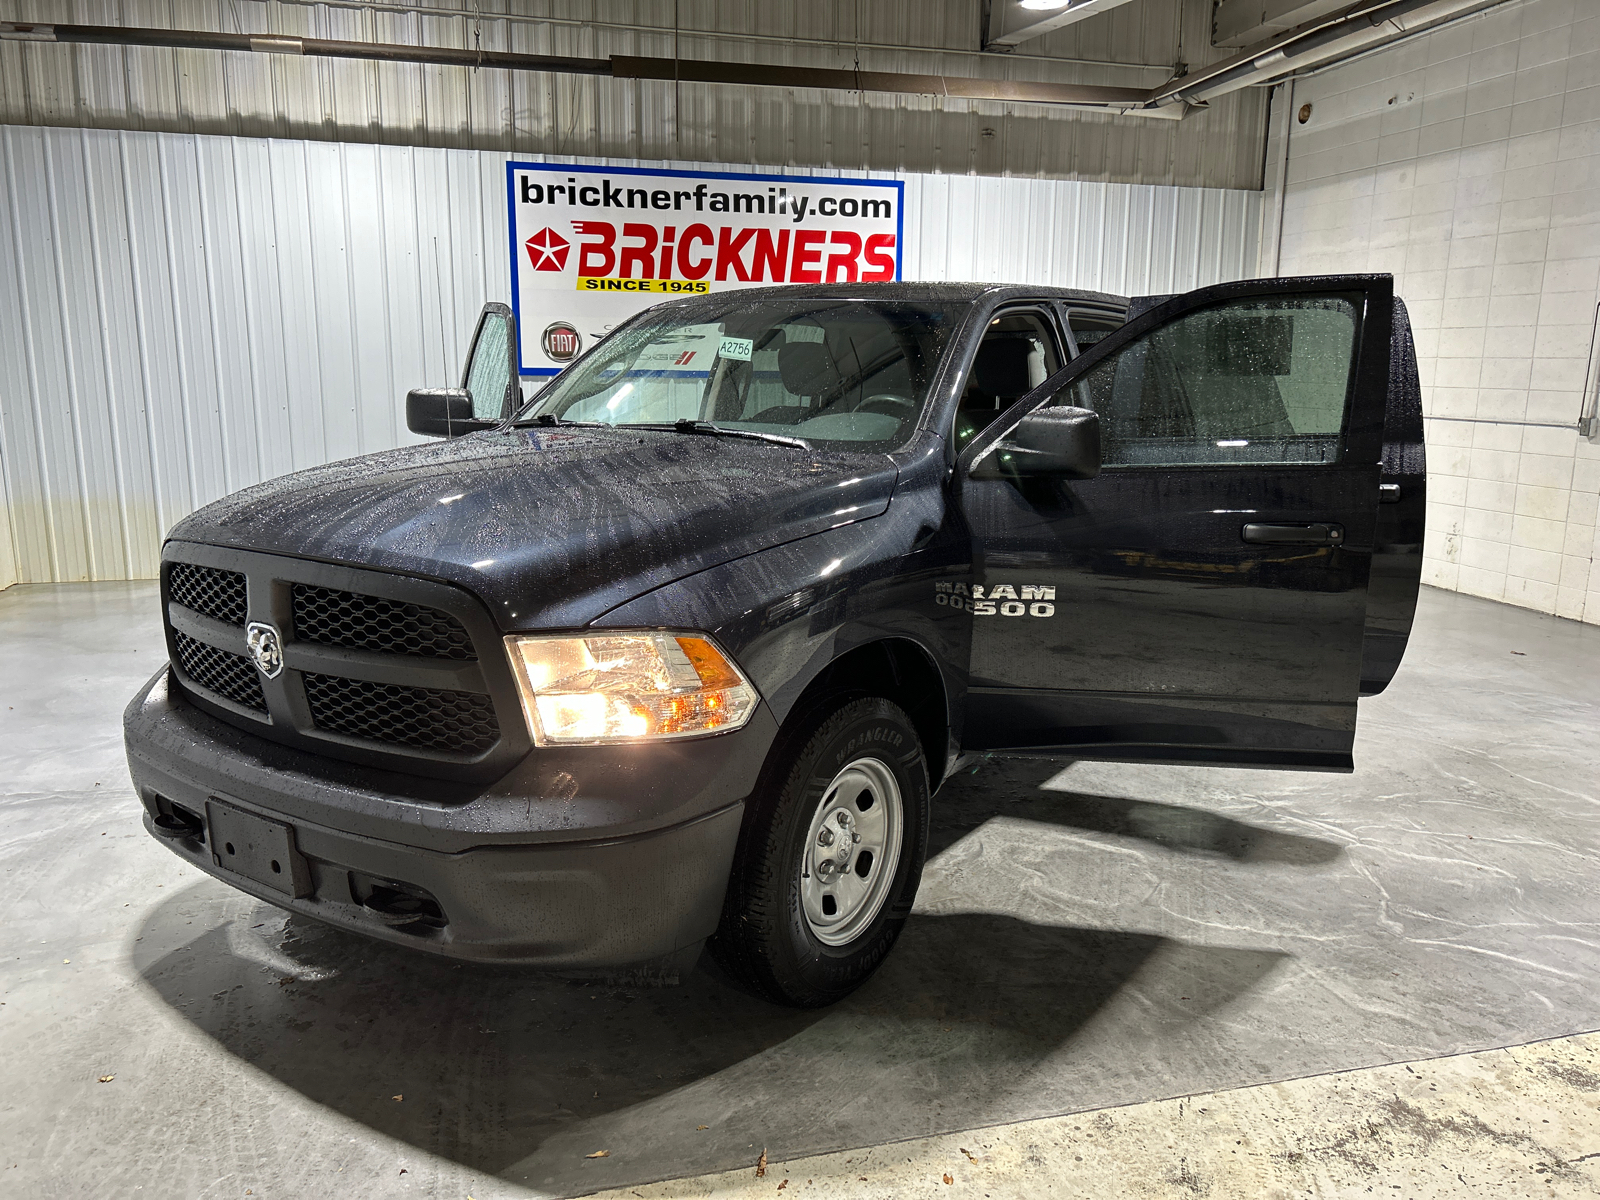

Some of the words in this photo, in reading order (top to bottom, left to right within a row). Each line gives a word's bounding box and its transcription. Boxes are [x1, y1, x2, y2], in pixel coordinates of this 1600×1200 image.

[520, 175, 892, 223] bricknerfamily.com
[586, 279, 650, 291] SINCE
[658, 281, 707, 293] 1945
[551, 333, 574, 353] FIAT
[719, 341, 750, 356] A2756
[835, 726, 904, 766] WRANGLER
